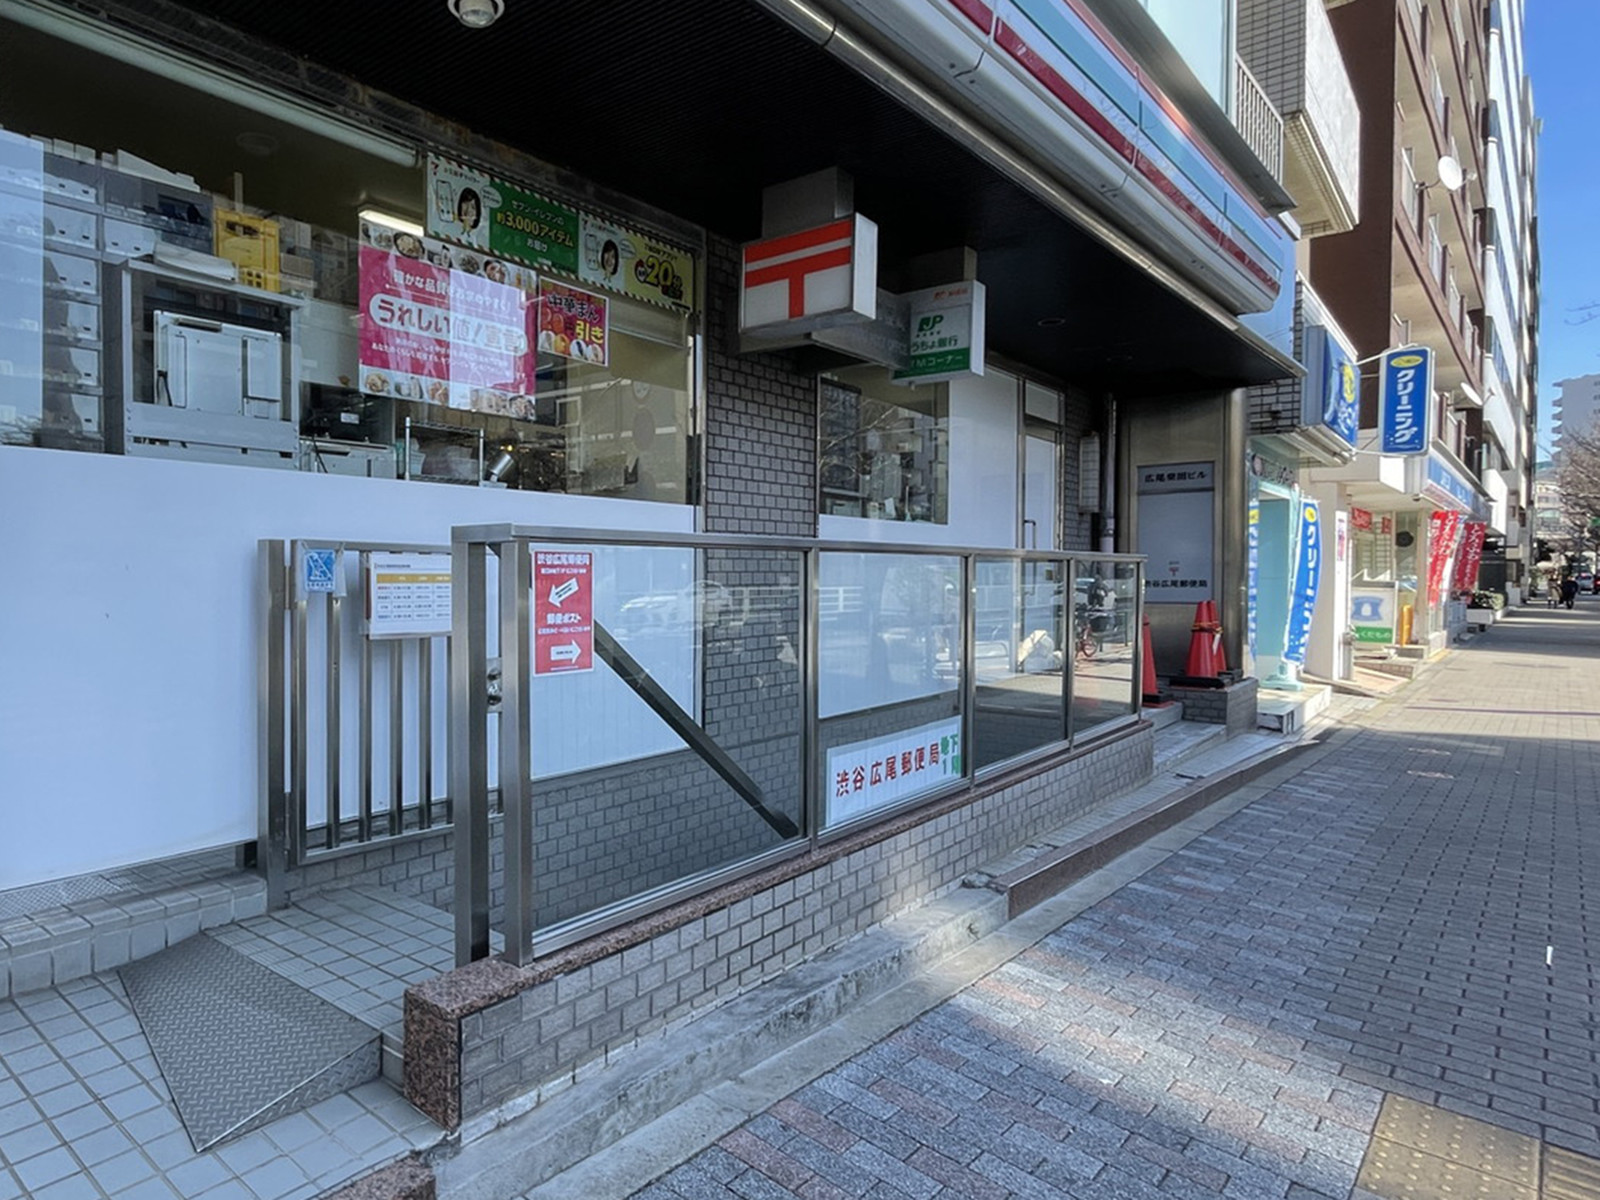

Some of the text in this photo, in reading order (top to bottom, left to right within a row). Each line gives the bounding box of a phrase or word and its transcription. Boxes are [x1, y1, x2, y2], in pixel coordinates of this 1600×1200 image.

[496, 211, 574, 247] 約3,000アイテム
[546, 293, 600, 323] 中華まん
[917, 314, 944, 332] JP
[911, 335, 958, 352] うちょ銀行
[911, 355, 963, 368] TMコーナー
[1394, 369, 1418, 443] クリーニング
[836, 742, 940, 797] 渋谷広尾郵便局
